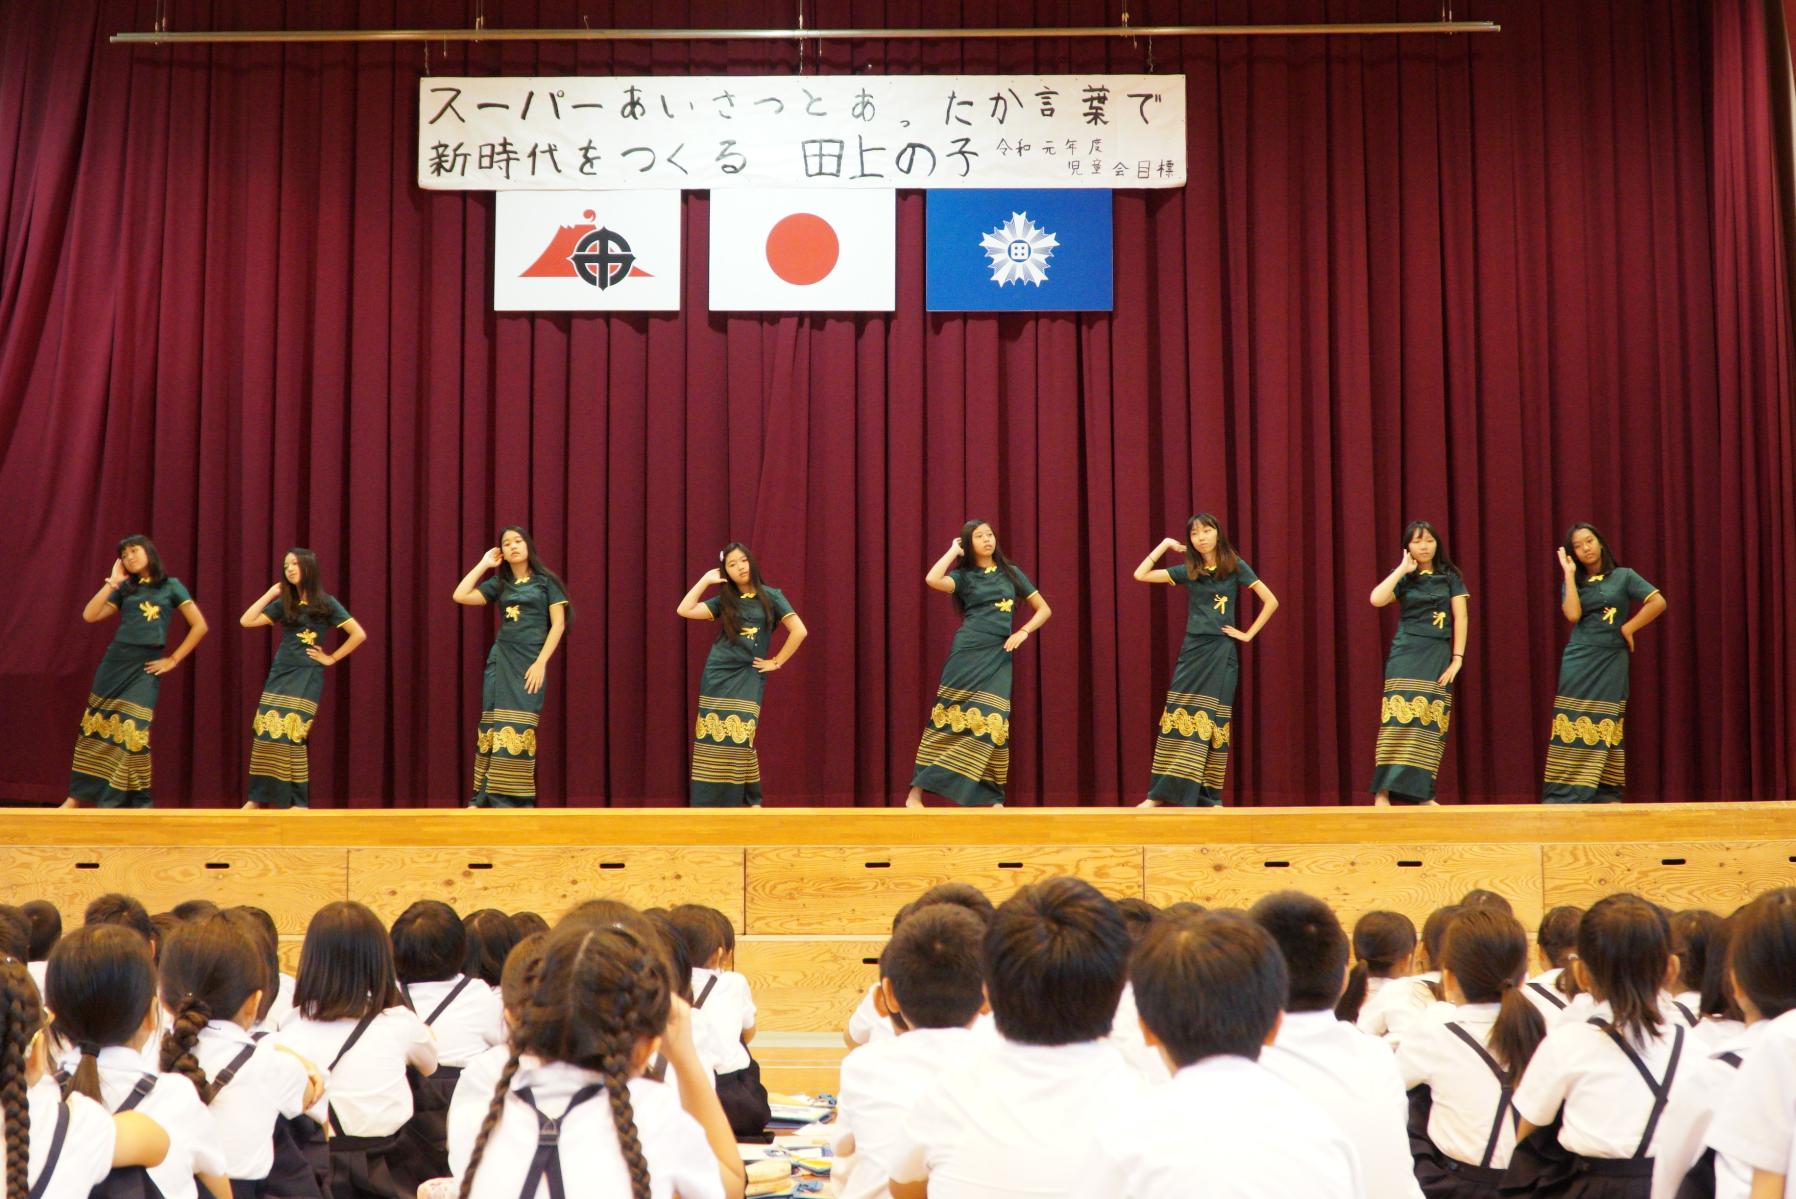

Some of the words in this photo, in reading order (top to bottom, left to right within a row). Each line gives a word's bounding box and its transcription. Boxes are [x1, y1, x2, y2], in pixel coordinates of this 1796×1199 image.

[428, 84, 1162, 128] スーパーあいさつとあったか言葉で
[428, 136, 747, 180] 新時代をつくる
[801, 134, 979, 179] 田上の子
[996, 137, 1103, 156] 令和元年度
[1067, 159, 1175, 178] 児童会目標
